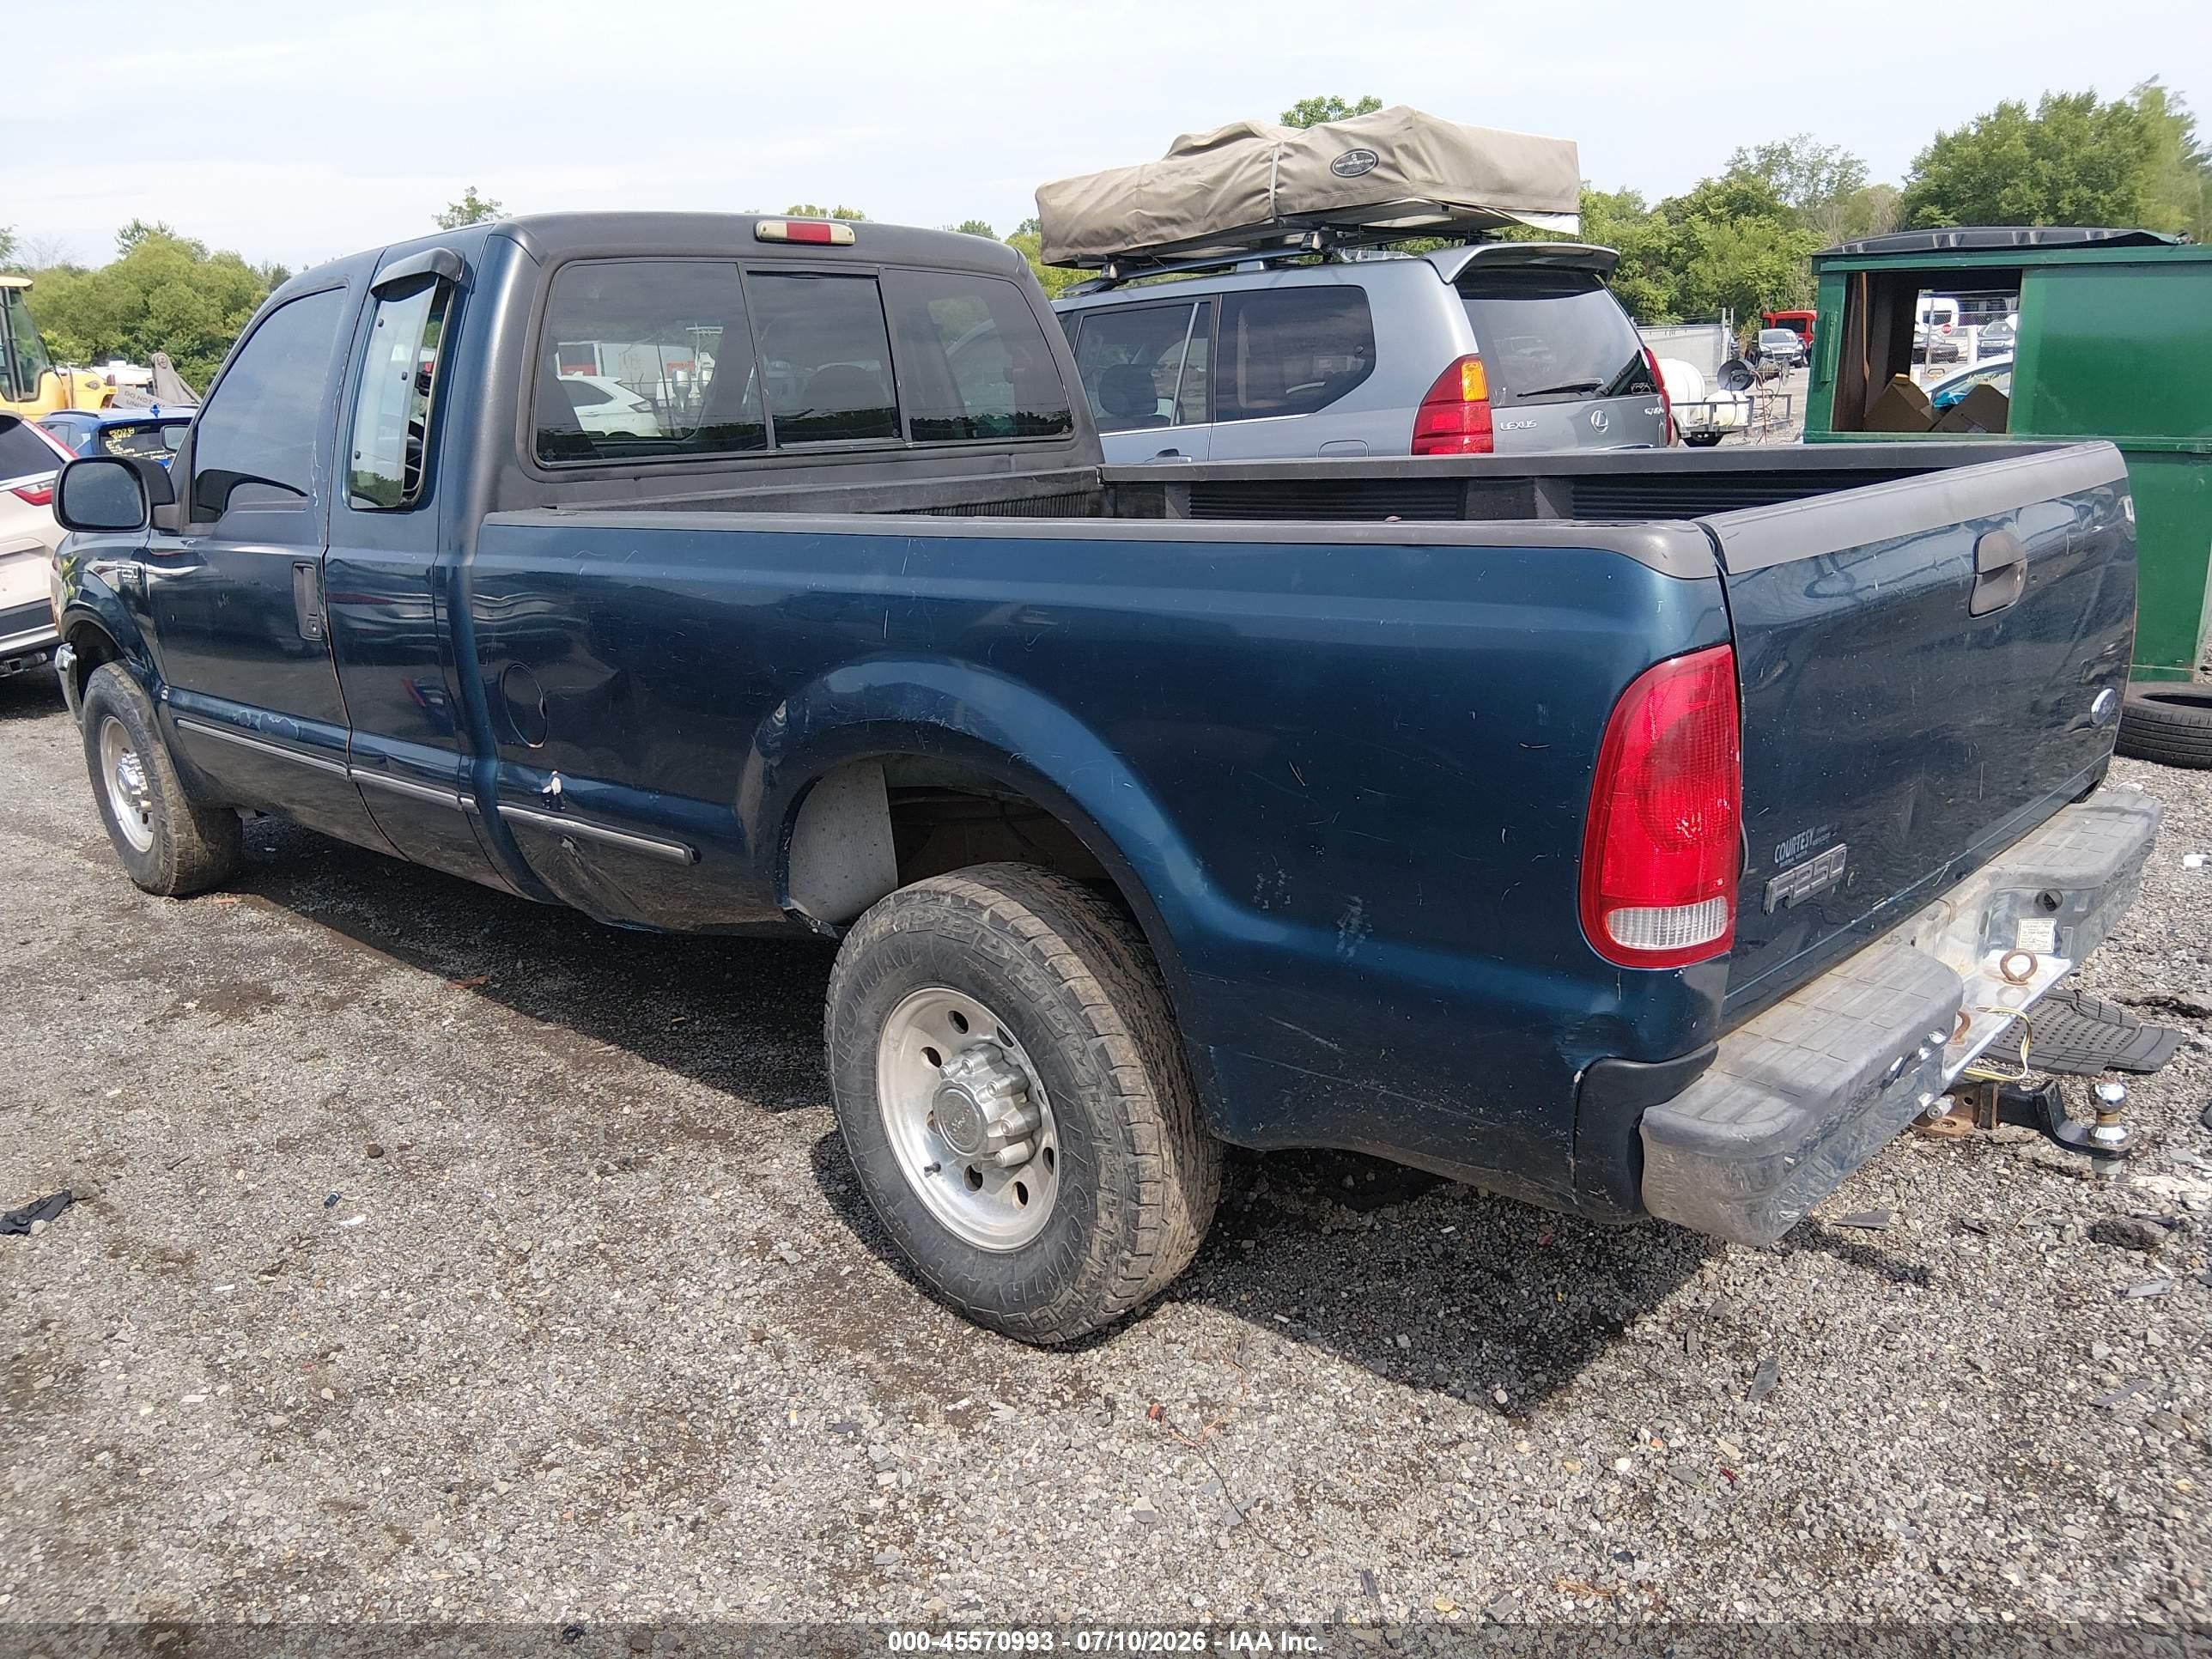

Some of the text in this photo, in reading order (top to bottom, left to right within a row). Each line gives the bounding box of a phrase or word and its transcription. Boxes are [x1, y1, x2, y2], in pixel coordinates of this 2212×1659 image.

[125, 390, 136, 398] DO
[137, 395, 153, 404] NOT
[1500, 419, 1538, 431] LEXUS
[1774, 826, 1815, 864] COURTESY
[1765, 842, 1847, 915] F250
[998, 1183, 1090, 1306] COUNTRY
